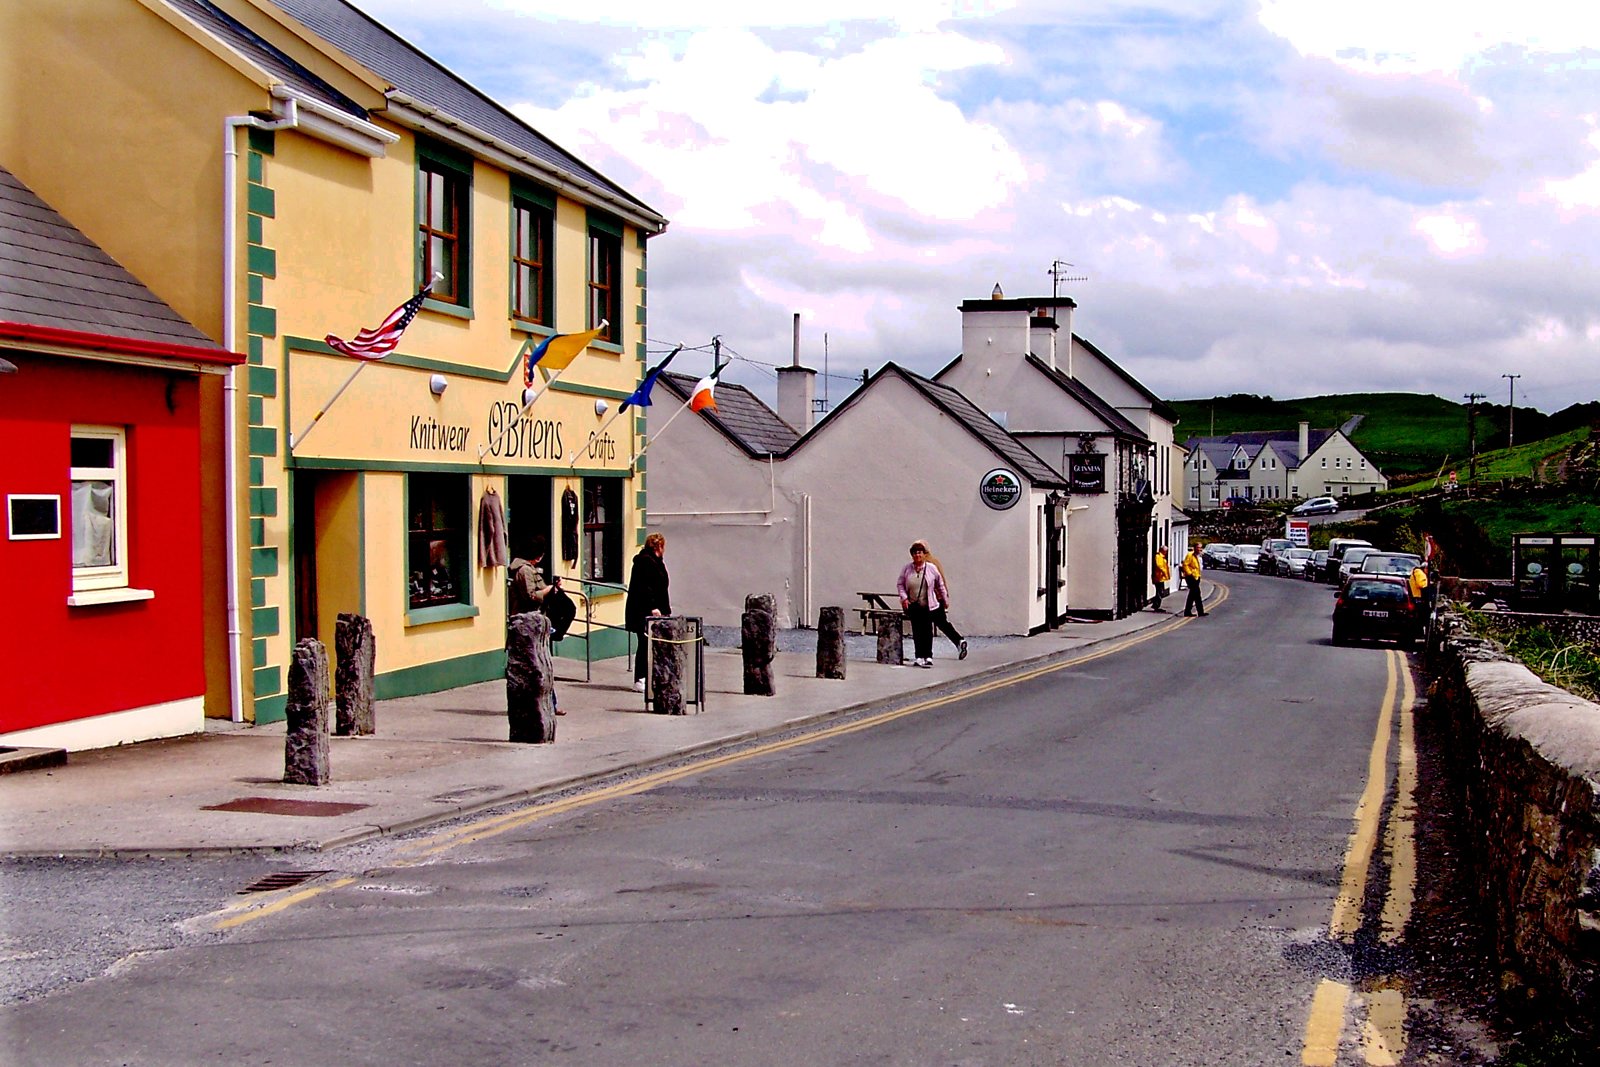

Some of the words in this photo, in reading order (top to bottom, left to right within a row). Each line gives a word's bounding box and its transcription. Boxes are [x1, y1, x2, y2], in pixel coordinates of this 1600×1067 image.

[410, 415, 470, 452] Knitwear
[488, 401, 563, 461] O'Briens
[588, 430, 616, 467] Crafts
[983, 485, 1017, 493] Heineken
